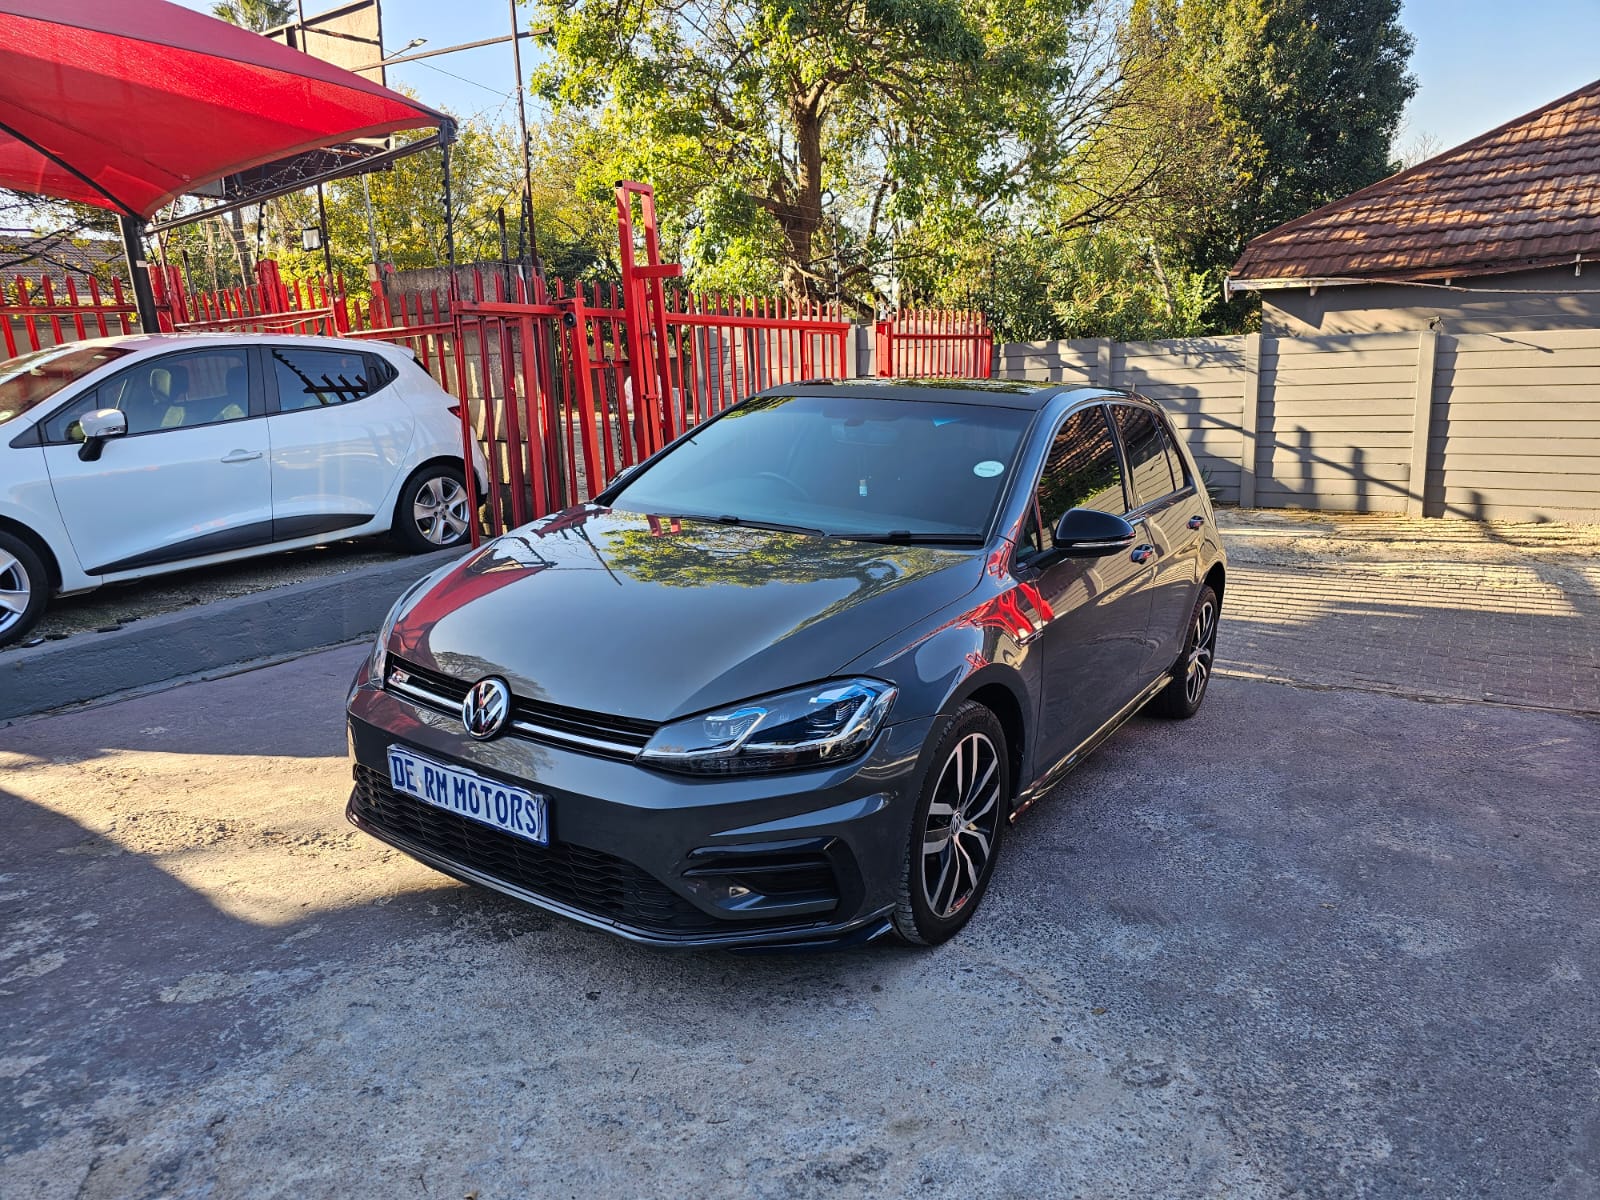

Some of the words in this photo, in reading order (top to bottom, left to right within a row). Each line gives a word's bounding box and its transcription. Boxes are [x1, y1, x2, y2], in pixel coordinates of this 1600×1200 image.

[391, 755, 417, 792] DE
[423, 766, 448, 806] RM
[453, 776, 537, 834] MOTORS
